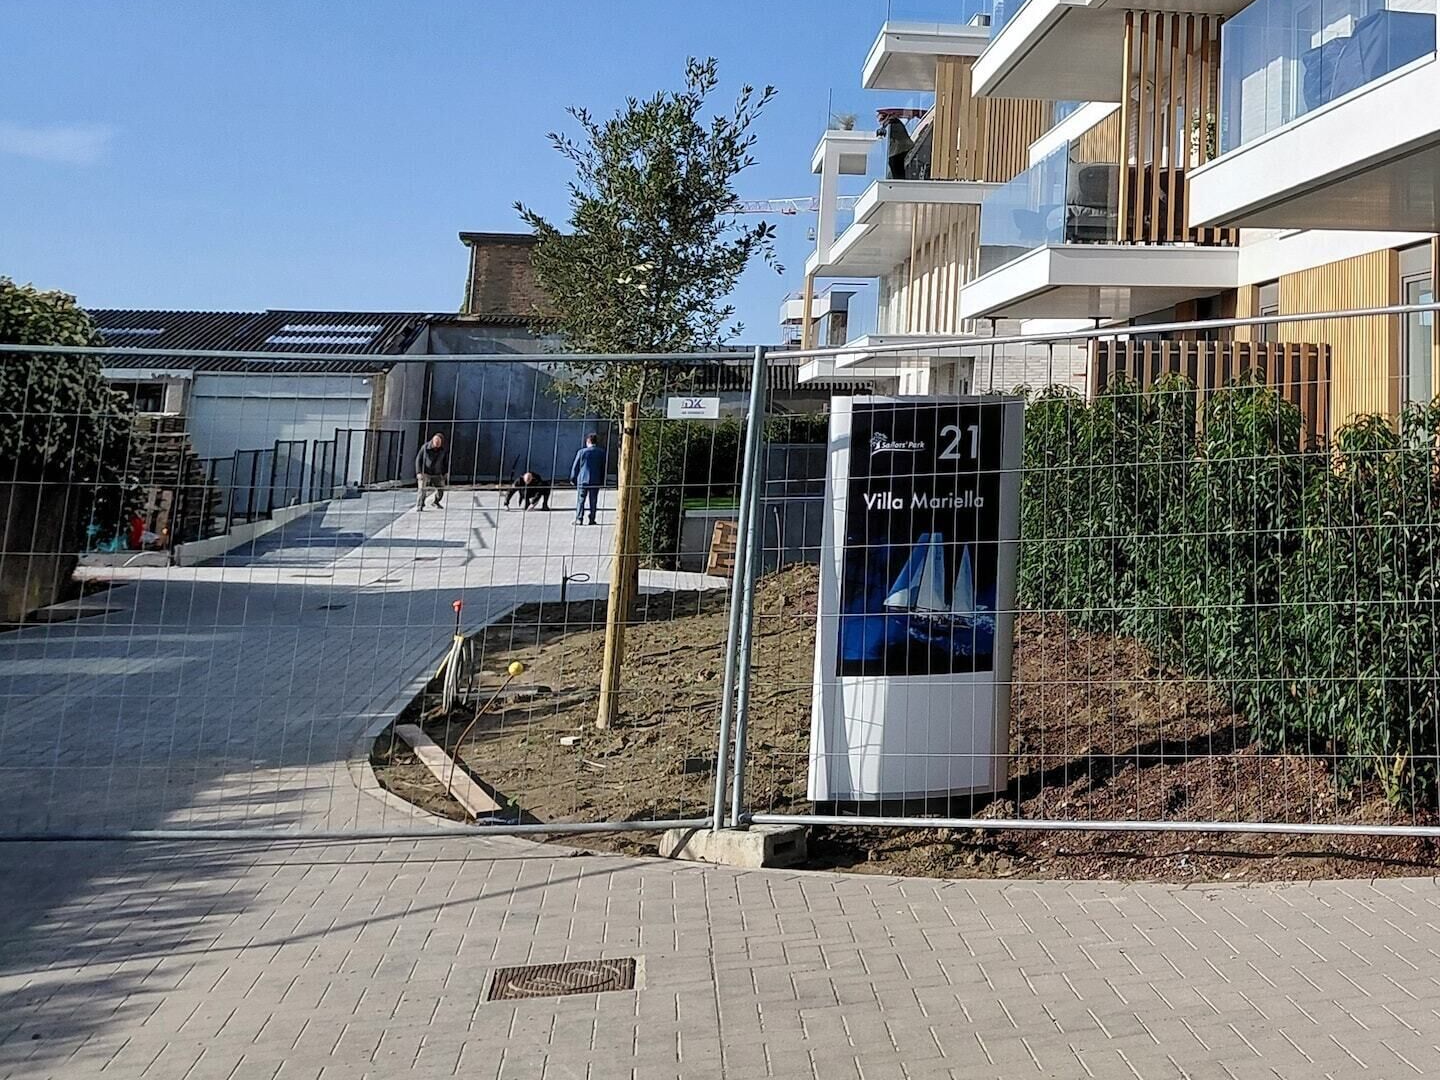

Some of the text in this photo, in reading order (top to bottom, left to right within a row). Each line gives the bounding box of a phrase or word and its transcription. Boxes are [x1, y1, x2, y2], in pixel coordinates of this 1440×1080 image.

[908, 440, 925, 448] Park
[937, 424, 979, 459] 21
[863, 489, 984, 510] Villa Mariella
